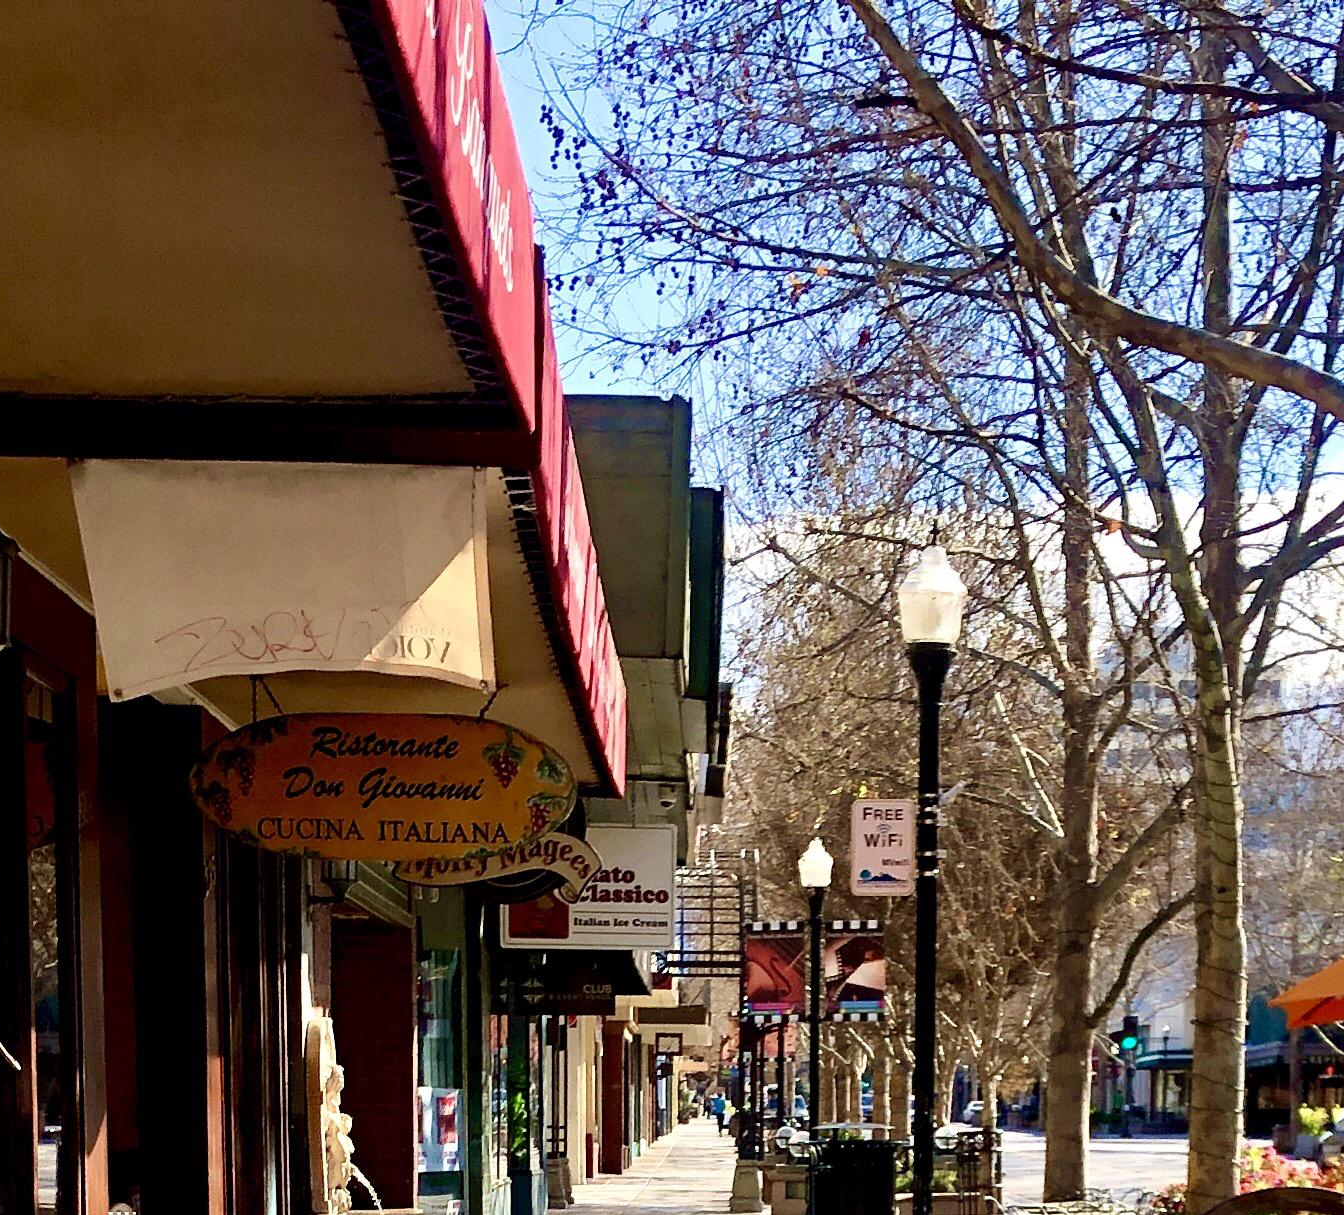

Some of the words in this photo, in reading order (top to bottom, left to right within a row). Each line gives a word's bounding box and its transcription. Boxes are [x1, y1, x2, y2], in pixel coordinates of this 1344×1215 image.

[310, 726, 459, 760] Ristorante
[283, 765, 345, 799] Don
[358, 766, 485, 808] Giovanni
[863, 807, 904, 821] FREE
[257, 817, 365, 841] CUCINA
[377, 820, 510, 844] ITALIANA
[864, 833, 904, 848] WiFi
[592, 866, 636, 884] ato
[573, 917, 611, 927] Italian
[613, 918, 630, 927] Ice
[632, 918, 669, 928] Cream
[583, 984, 612, 994] CLUB
